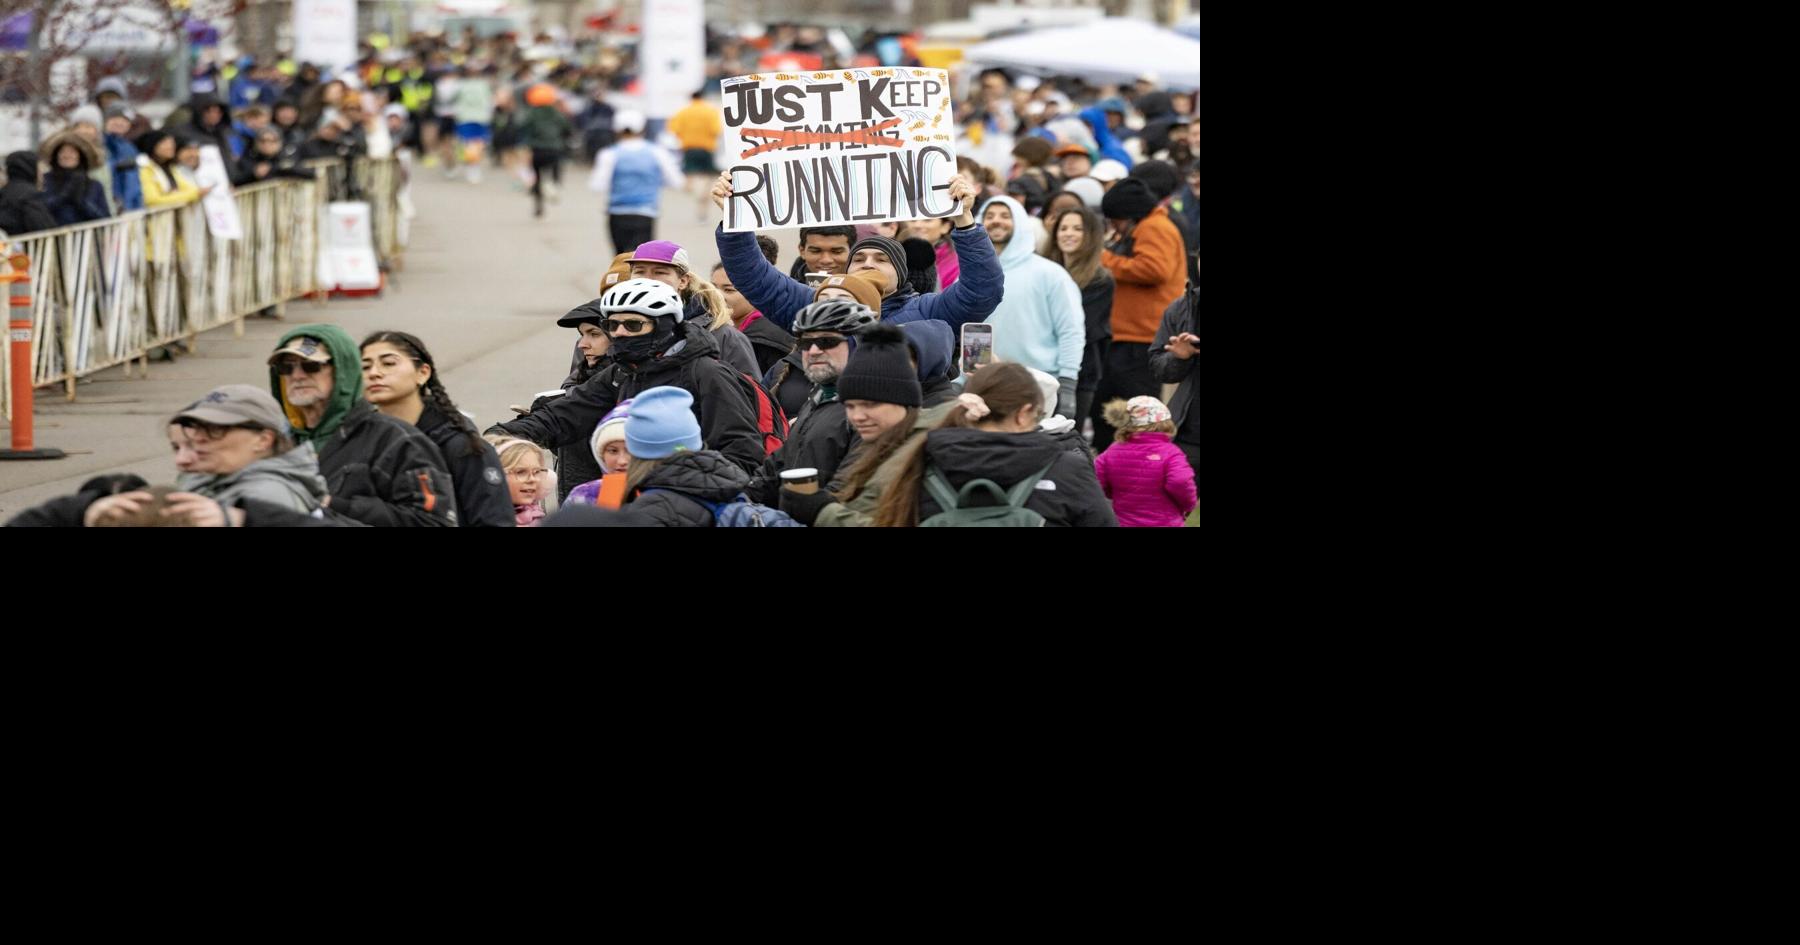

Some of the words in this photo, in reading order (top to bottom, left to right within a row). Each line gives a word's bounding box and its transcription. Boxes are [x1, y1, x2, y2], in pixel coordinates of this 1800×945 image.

[724, 81, 843, 127] JUST
[858, 77, 941, 121] KEEP
[741, 119, 900, 153] SWIMMING
[729, 145, 961, 229] RUNNING
